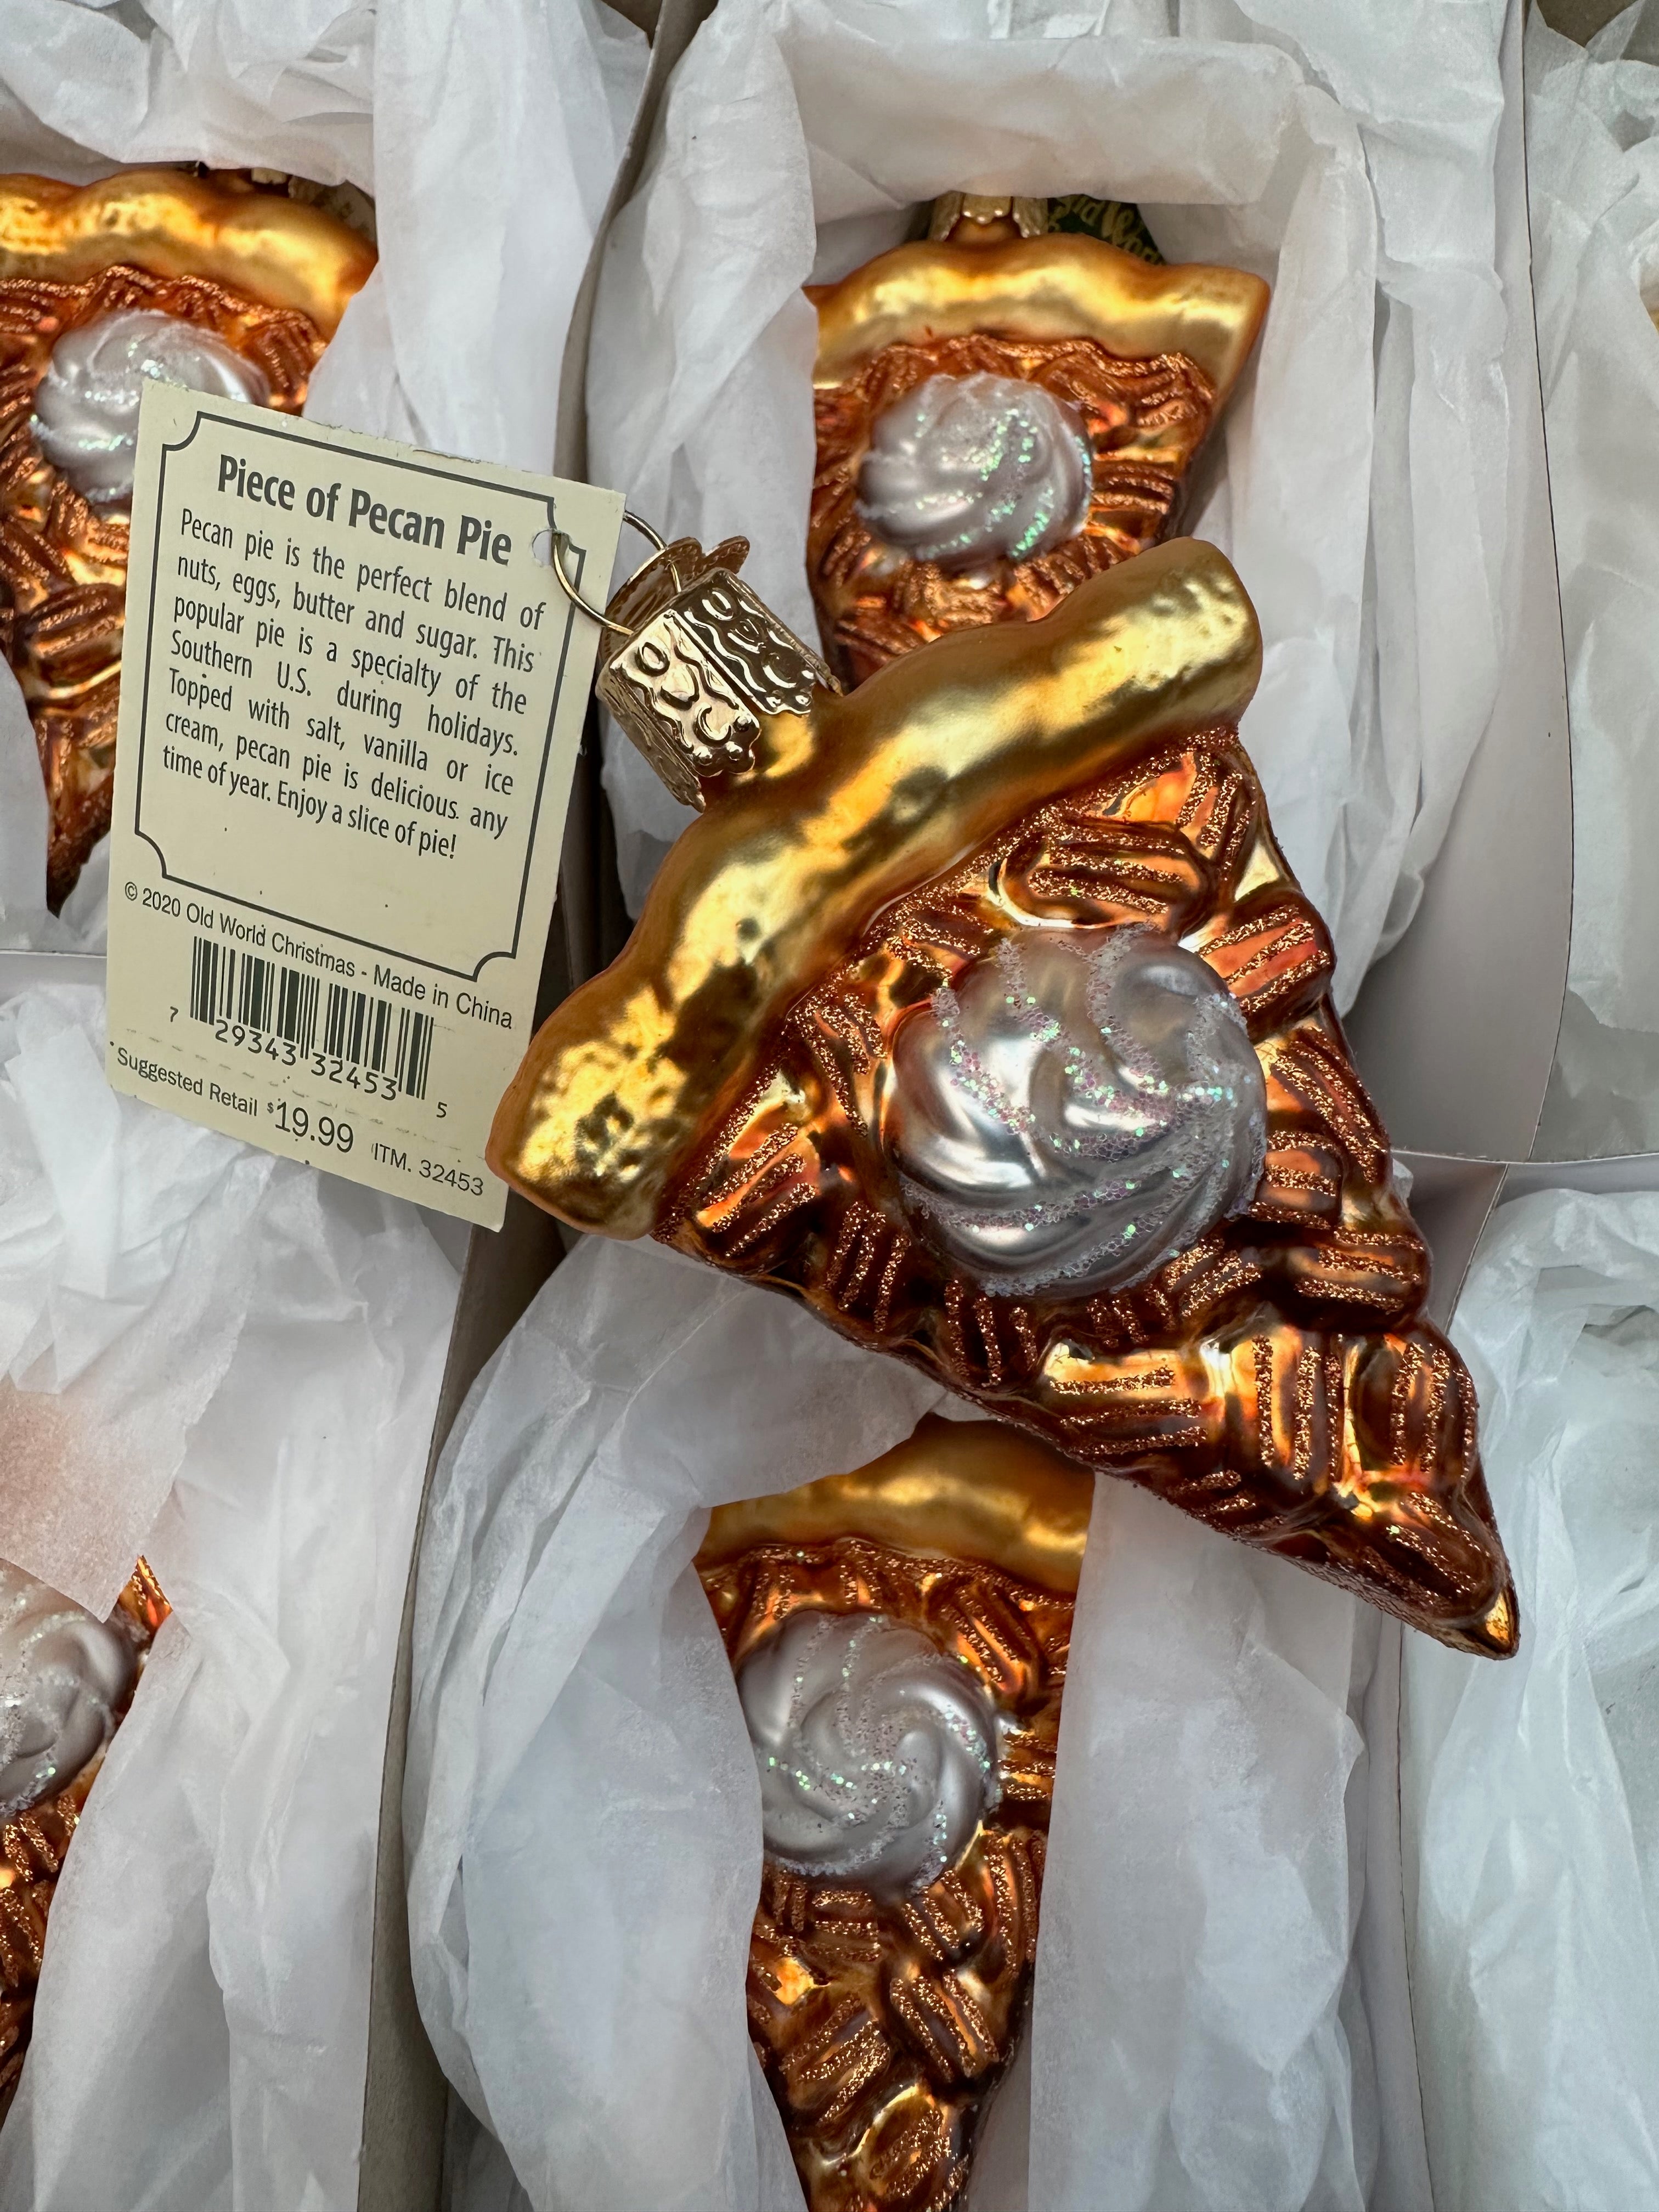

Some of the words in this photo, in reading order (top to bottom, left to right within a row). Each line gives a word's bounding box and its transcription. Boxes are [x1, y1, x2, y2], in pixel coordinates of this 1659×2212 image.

[182, 509, 233, 549] Pecan
[245, 530, 273, 561] pie
[286, 538, 300, 566] is
[313, 546, 345, 579] the
[357, 564, 432, 602] perfect
[444, 579, 507, 622] blend
[521, 602, 546, 630] of
[218, 454, 295, 511] Piece
[307, 483, 341, 522] of
[349, 488, 444, 549] Pecan
[457, 515, 511, 566] Pie
[174, 596, 244, 634] popular
[256, 618, 284, 647] pie
[299, 627, 313, 655] is
[326, 642, 337, 662] a
[351, 650, 441, 697] specialty
[456, 674, 480, 701] of
[492, 681, 526, 714] the
[178, 556, 220, 591] nuts,
[233, 573, 280, 608] eggs,
[294, 582, 355, 624] butter
[365, 611, 404, 639] and
[416, 624, 477, 658] sugar.
[494, 636, 534, 672] This
[170, 668, 232, 712] Topped
[249, 698, 289, 729] with
[306, 716, 345, 751] salt,
[364, 734, 427, 771] vanilla
[447, 760, 469, 781] or
[485, 764, 513, 795] ice
[171, 630, 252, 678] Southern
[278, 661, 311, 696] U.S.
[337, 680, 402, 729] during
[428, 704, 517, 757] holidays.
[163, 746, 202, 778] time
[208, 761, 227, 786] of
[229, 771, 270, 802] year.
[278, 780, 328, 823] Enjoy
[332, 805, 342, 823] a
[348, 805, 388, 838] slice
[395, 821, 417, 845] of
[419, 830, 456, 859] pie!
[166, 713, 223, 752] cream,
[236, 735, 290, 769] pecan
[303, 754, 331, 781] pie
[345, 763, 358, 789] is
[470, 808, 508, 839] any
[143, 888, 180, 917] 2020
[187, 903, 213, 929] Old
[220, 913, 266, 946] World
[272, 933, 354, 977] Christmas
[374, 964, 425, 1000] Made
[433, 984, 448, 1008] in
[456, 992, 511, 1029] China
[117, 1047, 202, 1096] Suggested
[210, 1083, 257, 1116] Retail
[267, 1101, 353, 1153] $19.99
[419, 1160, 483, 1195] 32453
[171, 1006, 178, 1022] 7
[215, 1019, 296, 1065] 29343
[311, 1052, 397, 1101] 32453
[437, 1102, 447, 1118] 5
